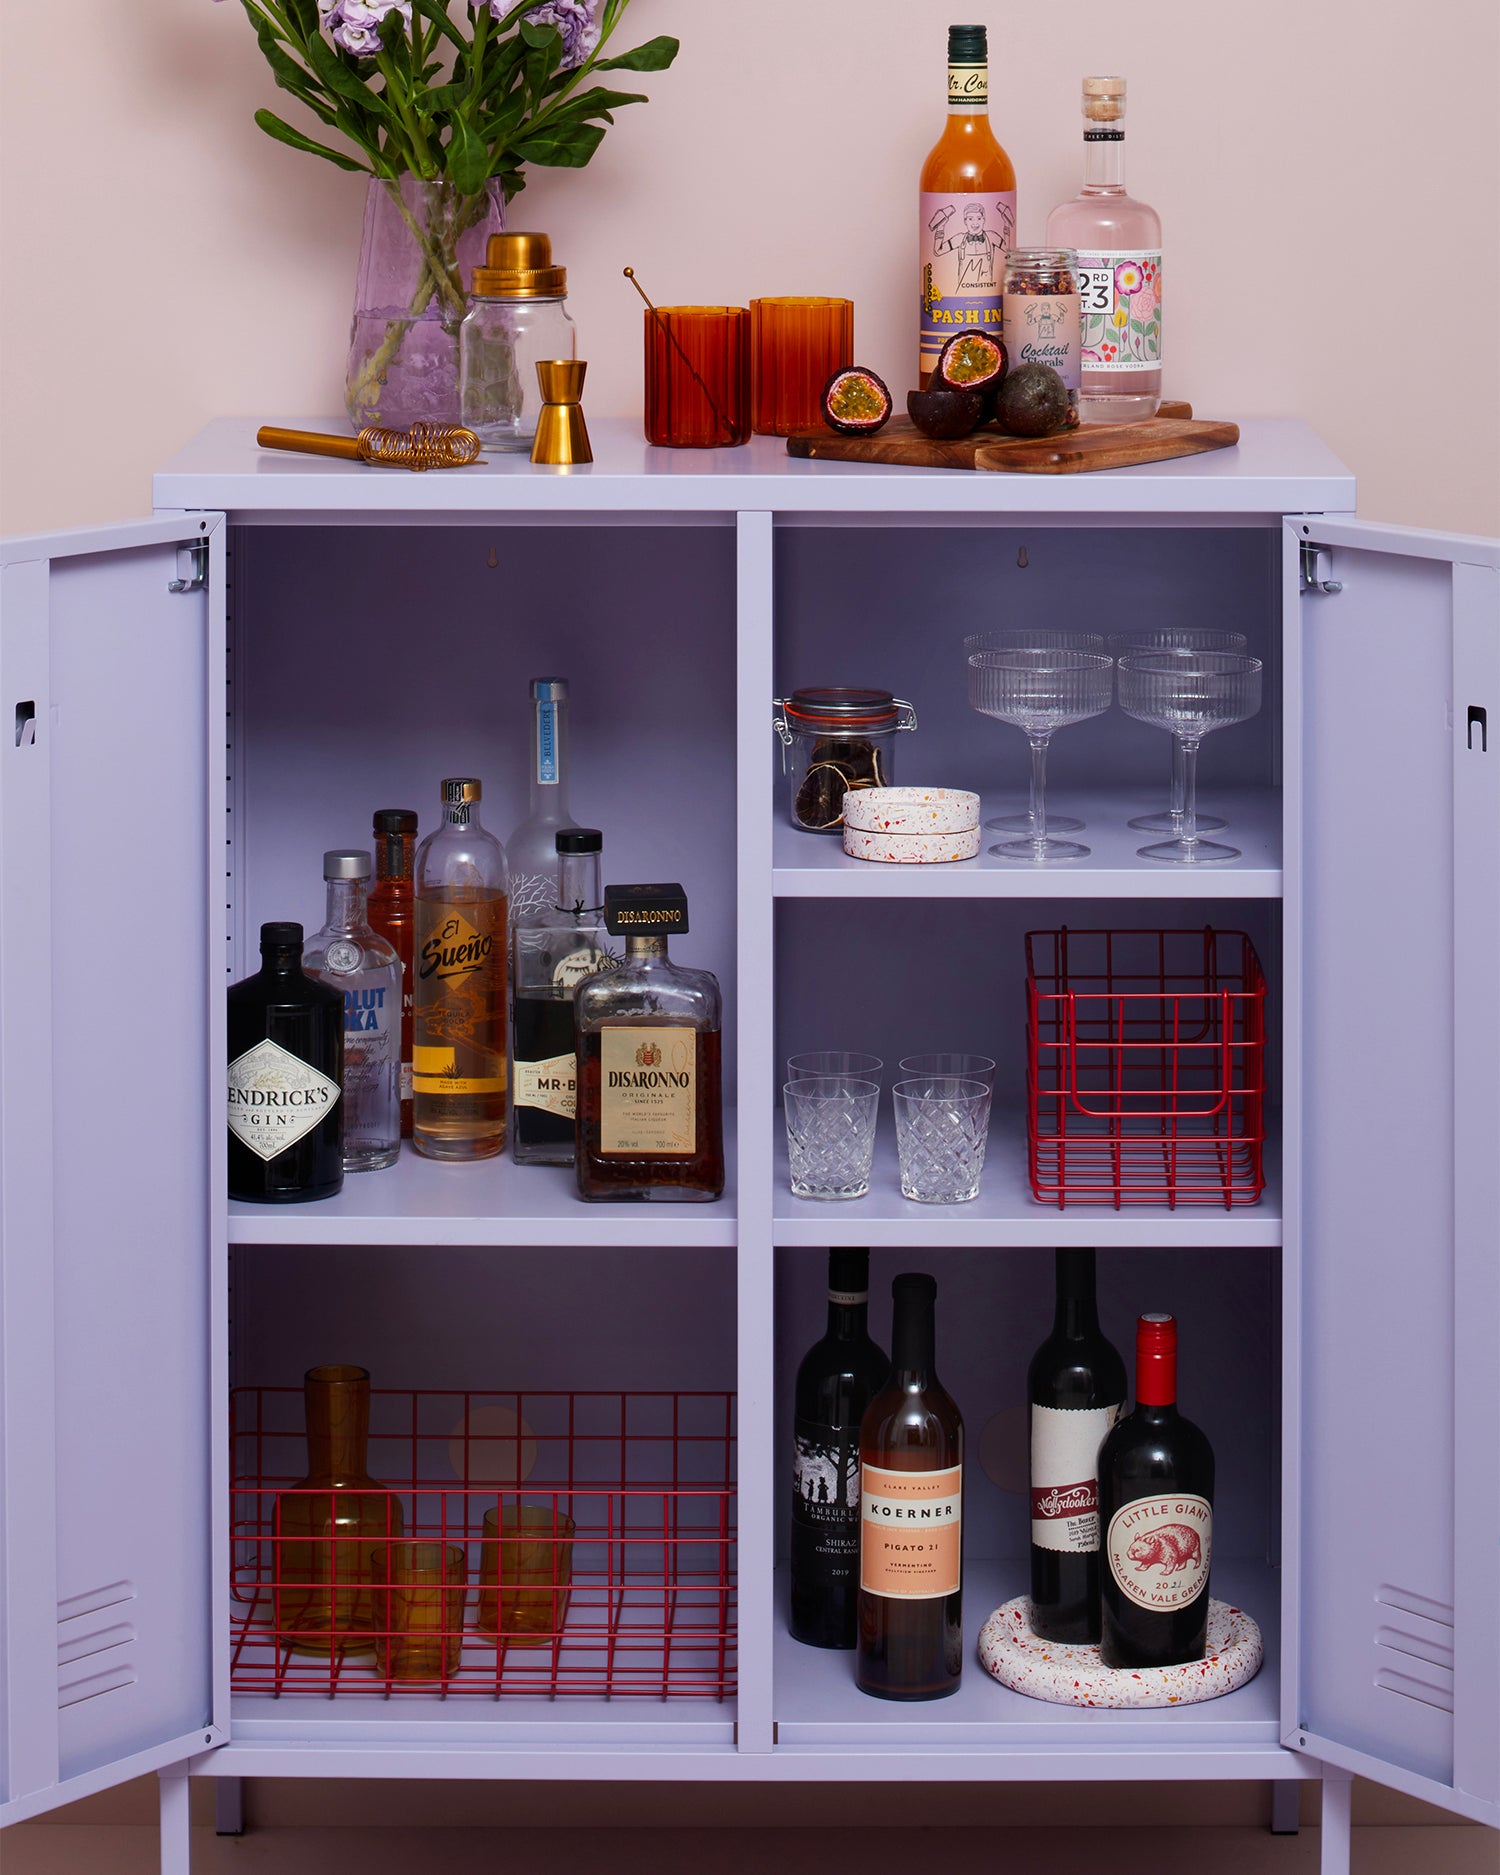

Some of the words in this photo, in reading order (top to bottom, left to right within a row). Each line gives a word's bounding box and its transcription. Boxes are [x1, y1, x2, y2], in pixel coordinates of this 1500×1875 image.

[1093, 273, 1109, 282] RD
[1092, 285, 1109, 309] 3
[932, 309, 979, 324] PASH
[1021, 342, 1070, 360] Cocktail
[617, 909, 682, 924] DISARONNO
[441, 919, 460, 940] El
[419, 933, 493, 980] Sueño
[608, 1071, 690, 1089] DISARONNO
[251, 1114, 287, 1125] GIN
[811, 1513, 845, 1523] ORGANIC
[871, 1504, 952, 1518] KOERNER
[1122, 1505, 1168, 1528] LITTLE
[1175, 1504, 1208, 1522] GIANT
[815, 1545, 841, 1554] CENTRAL
[826, 1539, 857, 1547] SHIRAZ
[884, 1543, 924, 1551] PIGATO
[1151, 1593, 1178, 1603] VALE
